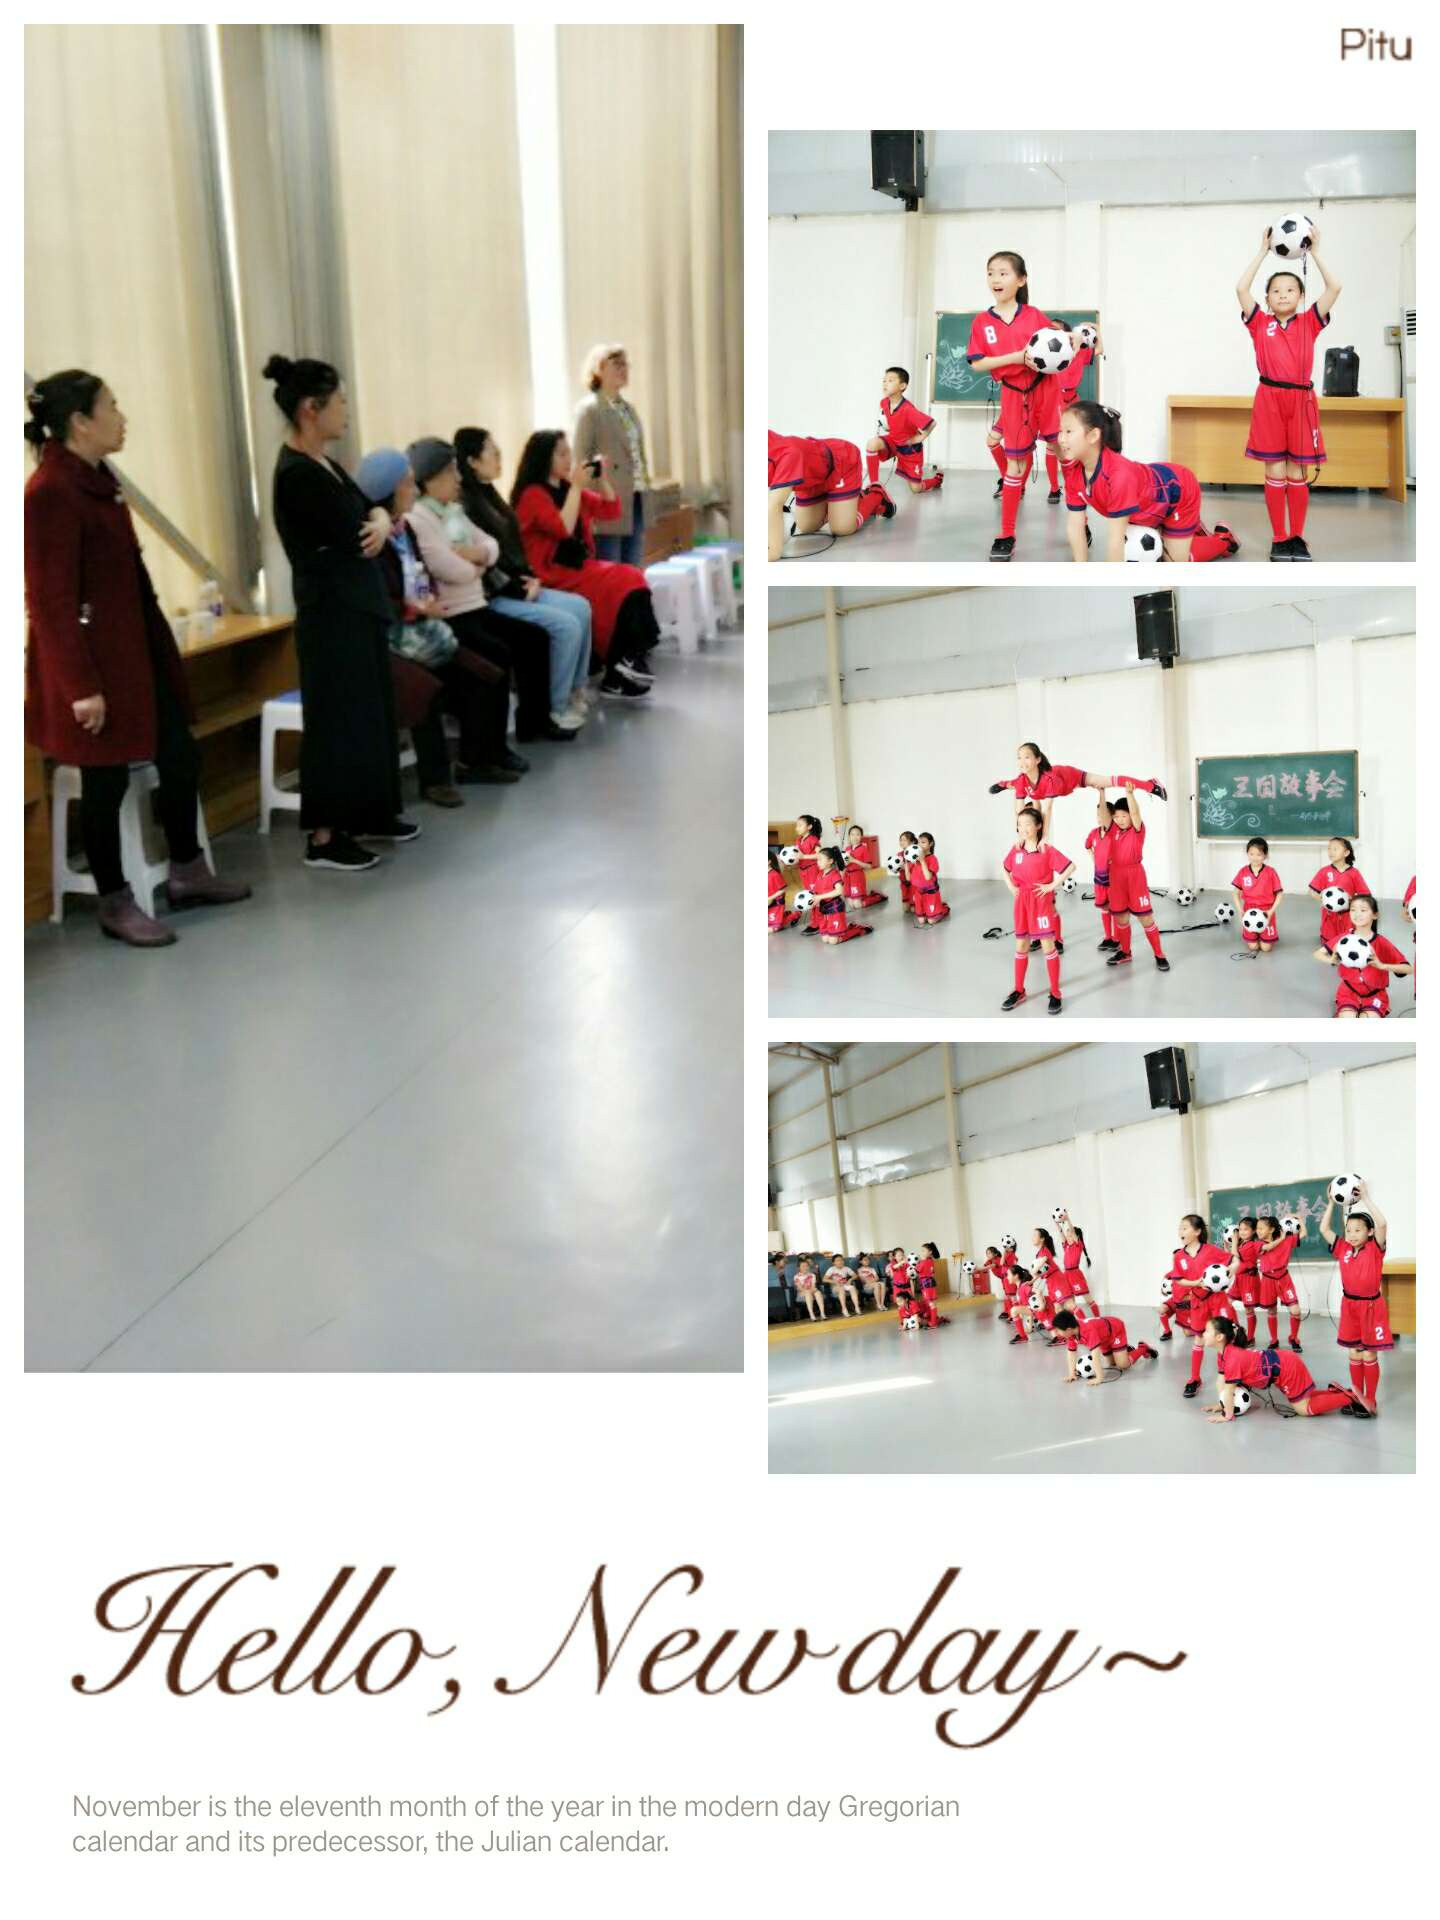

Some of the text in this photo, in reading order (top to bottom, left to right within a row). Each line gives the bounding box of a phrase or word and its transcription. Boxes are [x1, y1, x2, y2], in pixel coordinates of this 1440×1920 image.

[984, 325, 998, 344] 8
[1266, 321, 1277, 337] 2
[1139, 896, 1149, 907] 16
[1037, 916, 1050, 929] 10
[1375, 1326, 1384, 1340] 2
